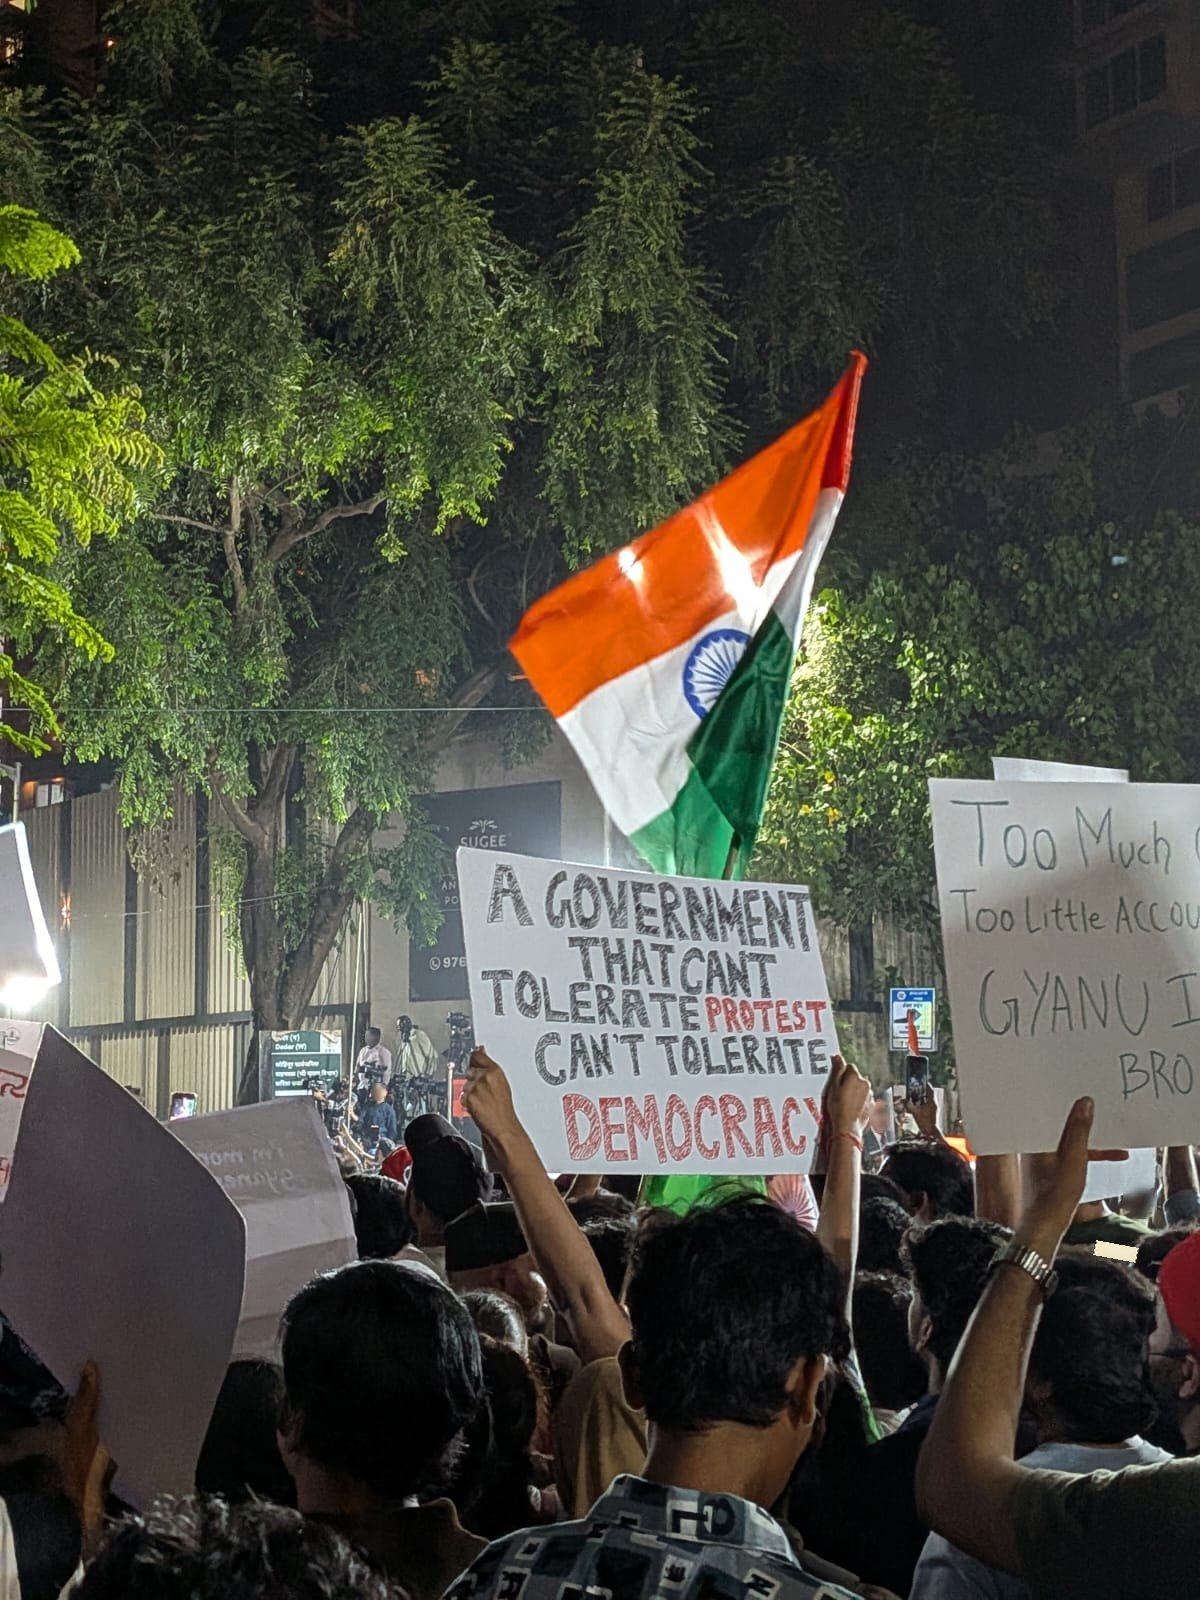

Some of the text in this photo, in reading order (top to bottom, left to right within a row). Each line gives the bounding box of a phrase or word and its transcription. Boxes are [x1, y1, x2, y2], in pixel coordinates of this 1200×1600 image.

[460, 833, 507, 848] SUGEE
[1075, 806, 1170, 875] Much
[486, 863, 811, 952] A GOVERNMENT
[1025, 896, 1105, 934] Little
[568, 936, 676, 988] THAT
[481, 969, 827, 1033] TOLERATE PROTEST
[979, 969, 1149, 1037] GYANU
[535, 1031, 829, 1085] CAN'T TOLERATE
[1119, 1050, 1193, 1100] BRO
